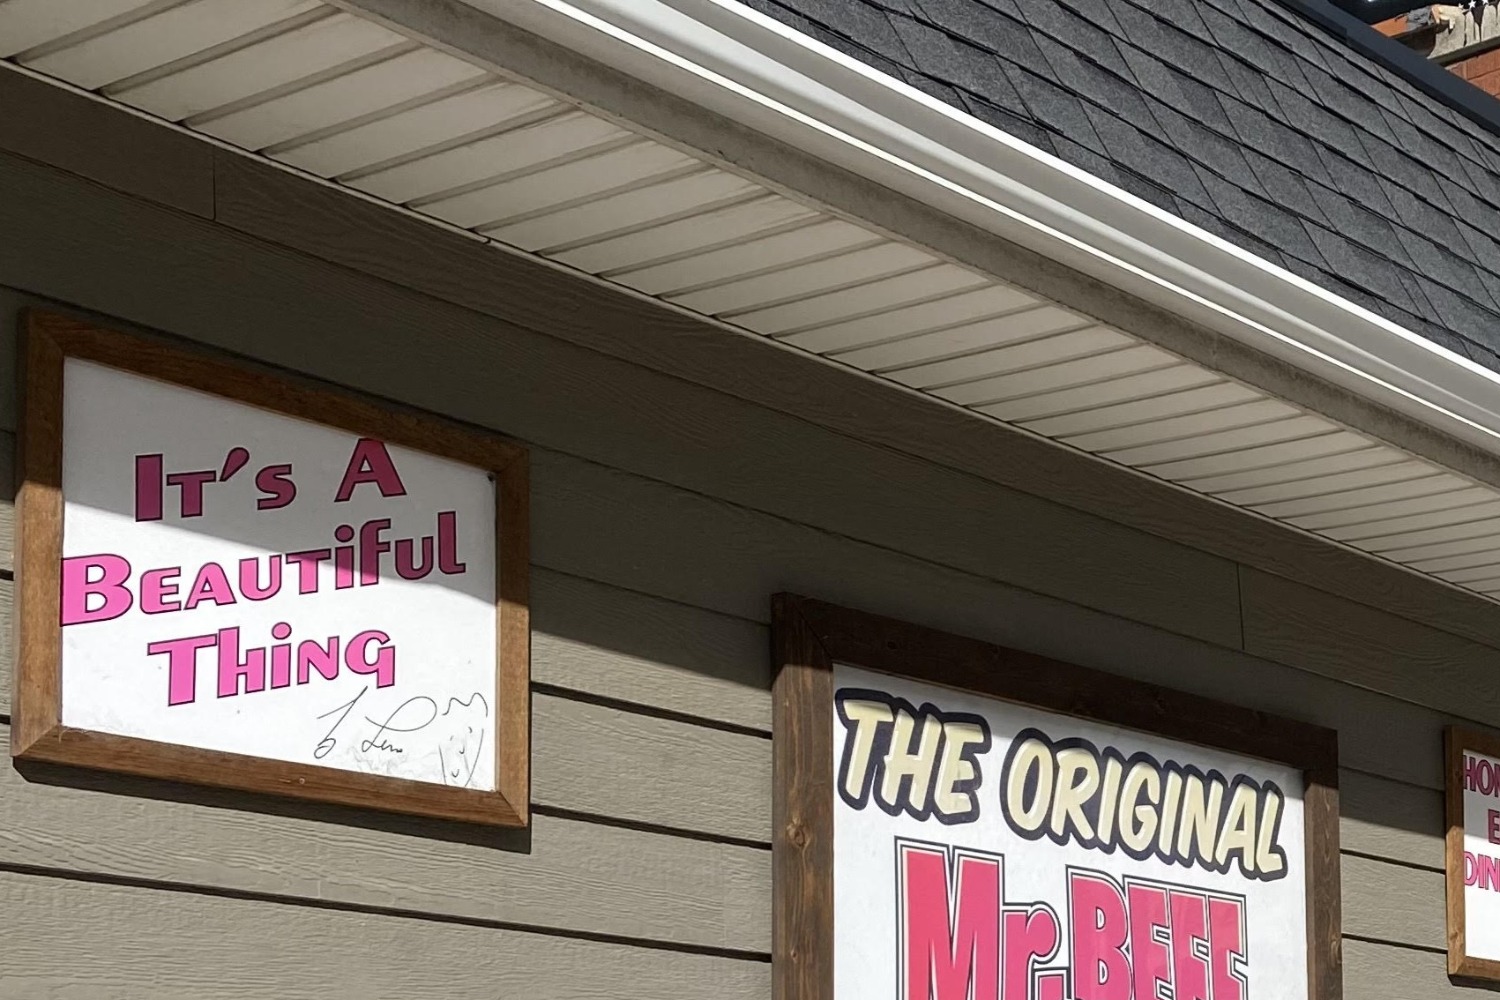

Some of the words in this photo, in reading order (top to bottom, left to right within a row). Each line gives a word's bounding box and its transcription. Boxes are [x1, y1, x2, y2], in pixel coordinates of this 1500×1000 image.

[334, 436, 407, 502] A
[834, 688, 991, 826] THE
[1000, 728, 1288, 881] ORIGINAL
